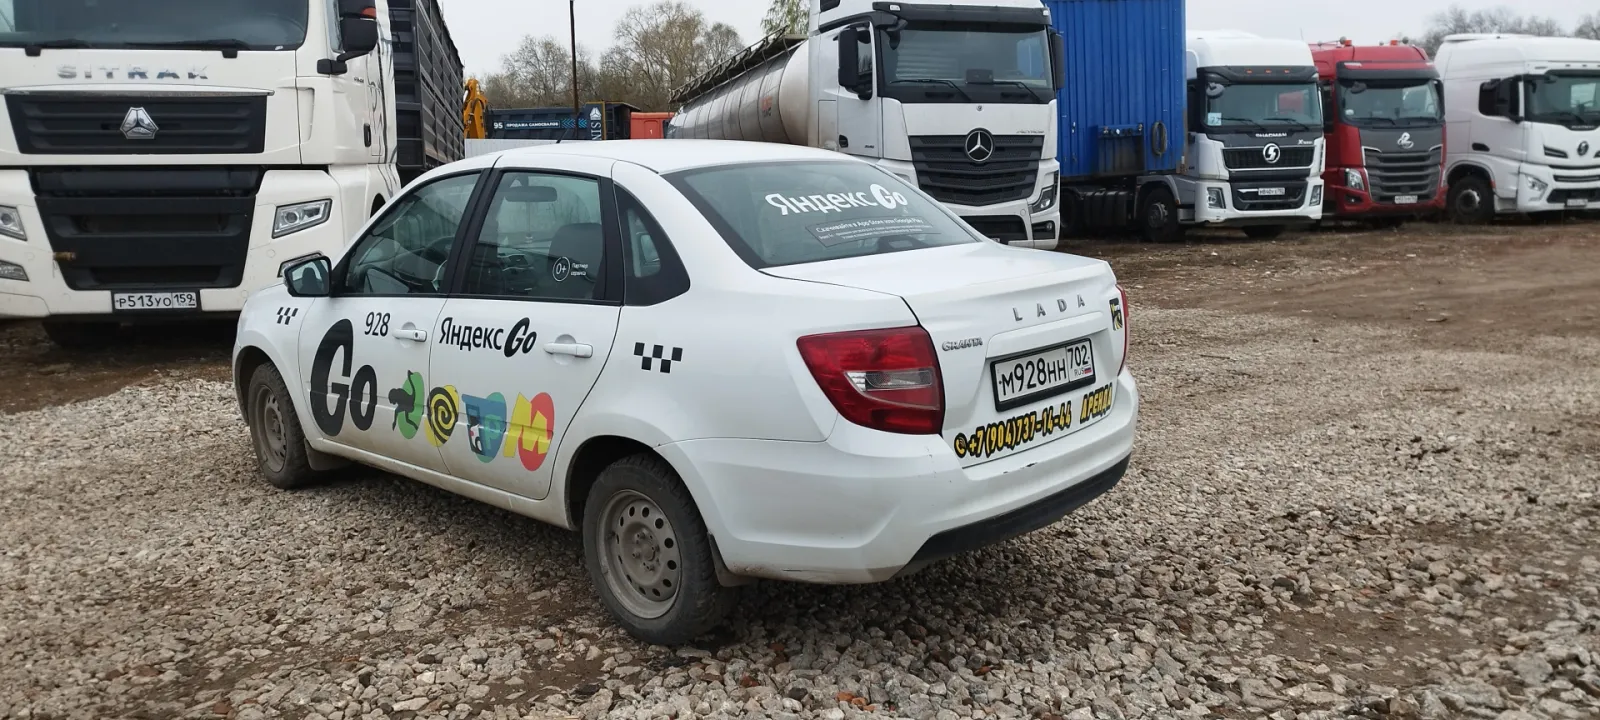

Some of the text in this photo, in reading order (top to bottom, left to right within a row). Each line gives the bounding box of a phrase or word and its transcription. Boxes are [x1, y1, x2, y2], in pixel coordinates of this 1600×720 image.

[57, 63, 208, 79] SITRAK
[765, 183, 908, 215] Яндекс Go
[556, 263, 566, 275] 0+
[173, 293, 194, 304] 159
[1013, 294, 1085, 321] LADA
[364, 311, 390, 337] 928
[439, 317, 537, 358] Яндекс Go
[942, 337, 983, 351] GRANTA
[310, 318, 377, 437] Go
[1001, 344, 1089, 396] М928НН 702
[1080, 382, 1113, 424] АРЕНДА
